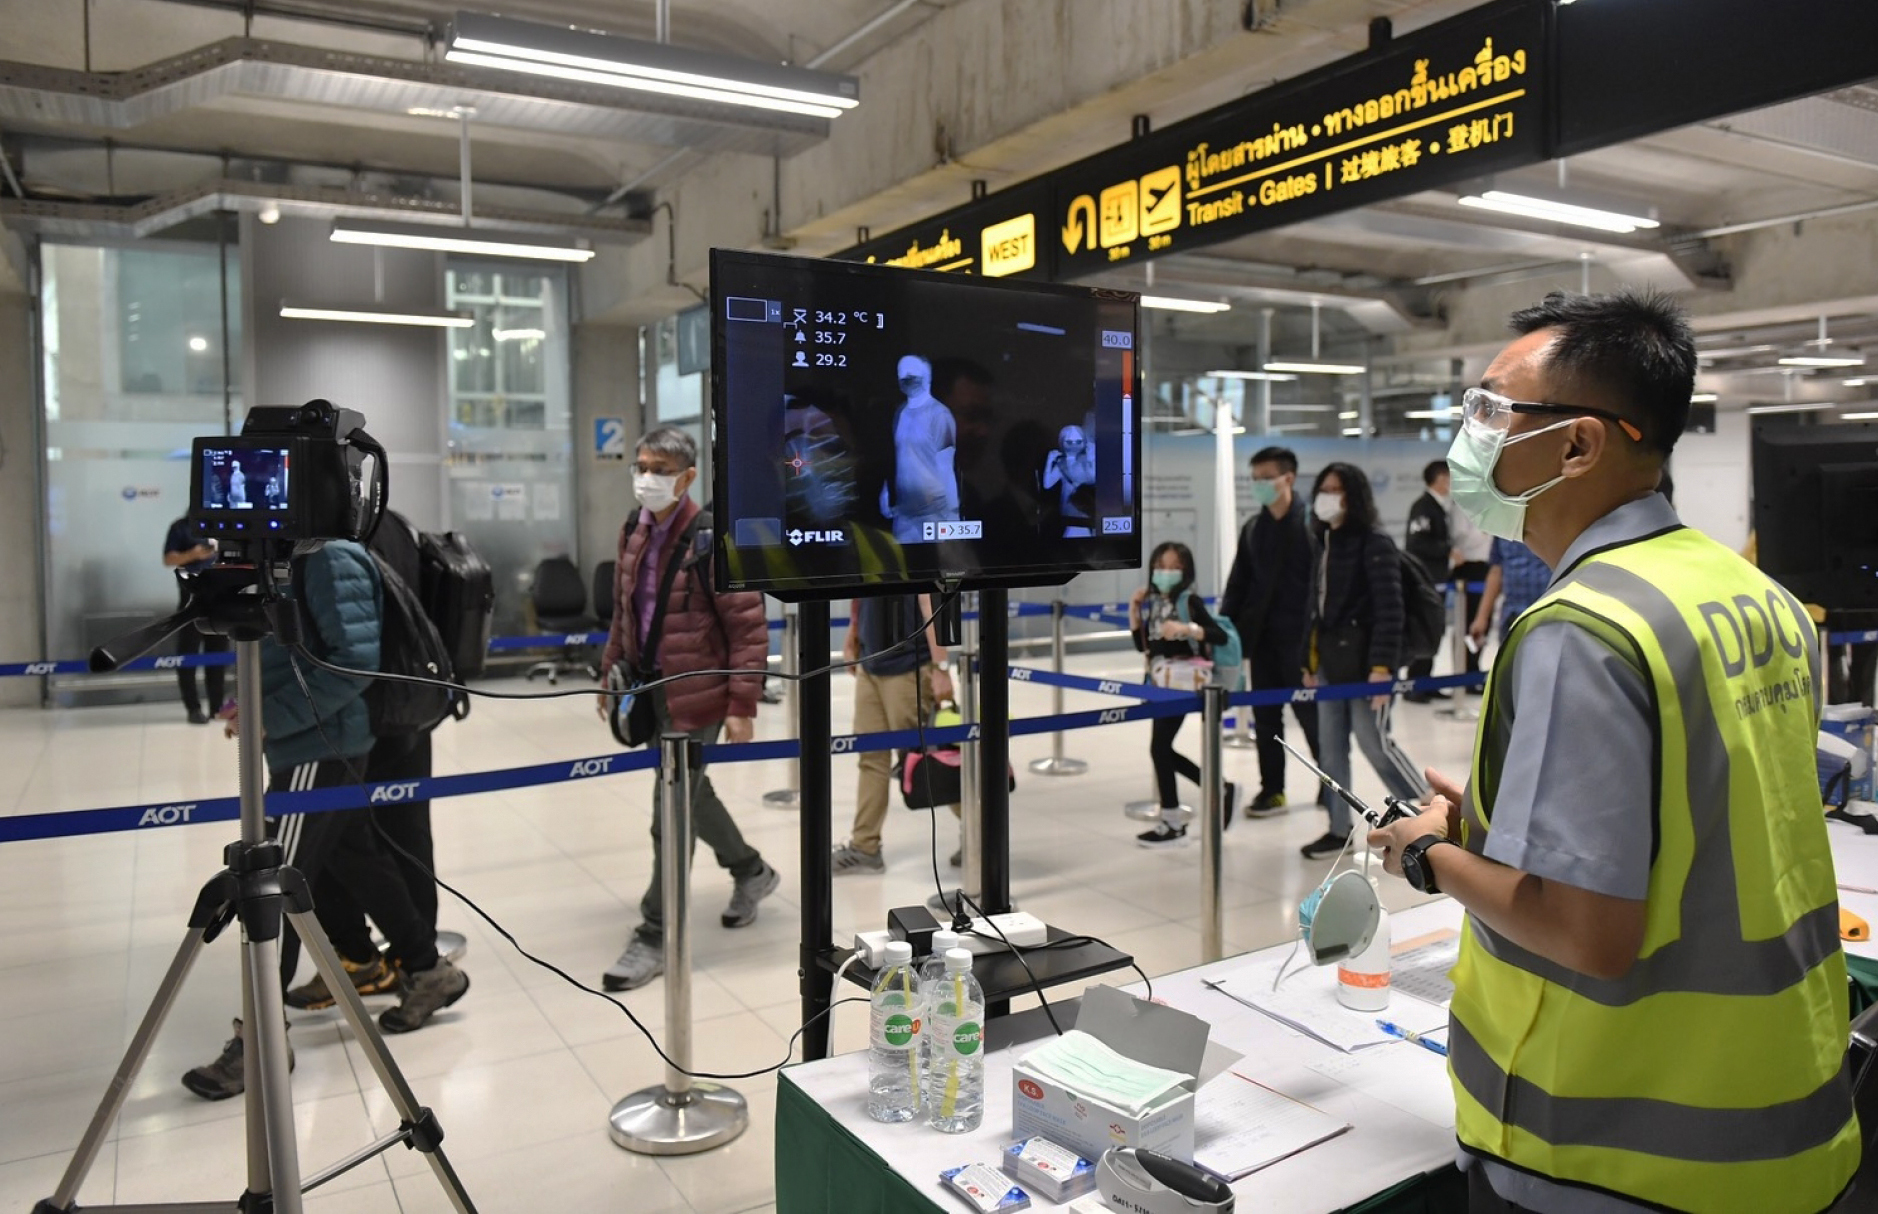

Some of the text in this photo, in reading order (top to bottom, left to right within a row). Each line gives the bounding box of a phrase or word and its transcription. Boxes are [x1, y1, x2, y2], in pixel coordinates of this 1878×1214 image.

[1185, 36, 1527, 190] ผู้โดยสารผ่าน ทางออกขึ้นเครื่อง
[1339, 111, 1514, 184] 过境旅客 登机门
[1186, 172, 1317, 226] Transit Gates
[988, 234, 1029, 263] WEST
[815, 310, 847, 325] 34.2
[814, 331, 847, 345] 35.7
[1103, 334, 1131, 346] 40.0
[815, 353, 847, 367] 29.2
[601, 419, 625, 453] 2
[957, 524, 981, 536] 35.7
[1104, 520, 1131, 531] 25.0
[804, 530, 844, 543] FLIR
[1697, 589, 1802, 679] DDC
[25, 662, 57, 675] AOT
[155, 656, 185, 668] AOT
[1011, 667, 1032, 680] AOT
[1098, 681, 1122, 694] AOT
[1291, 689, 1317, 702] AOT
[1099, 709, 1128, 724] AOT
[569, 757, 613, 778] AOT
[370, 782, 420, 803] AOT
[138, 805, 196, 827] AOT
[954, 1032, 983, 1043] care
